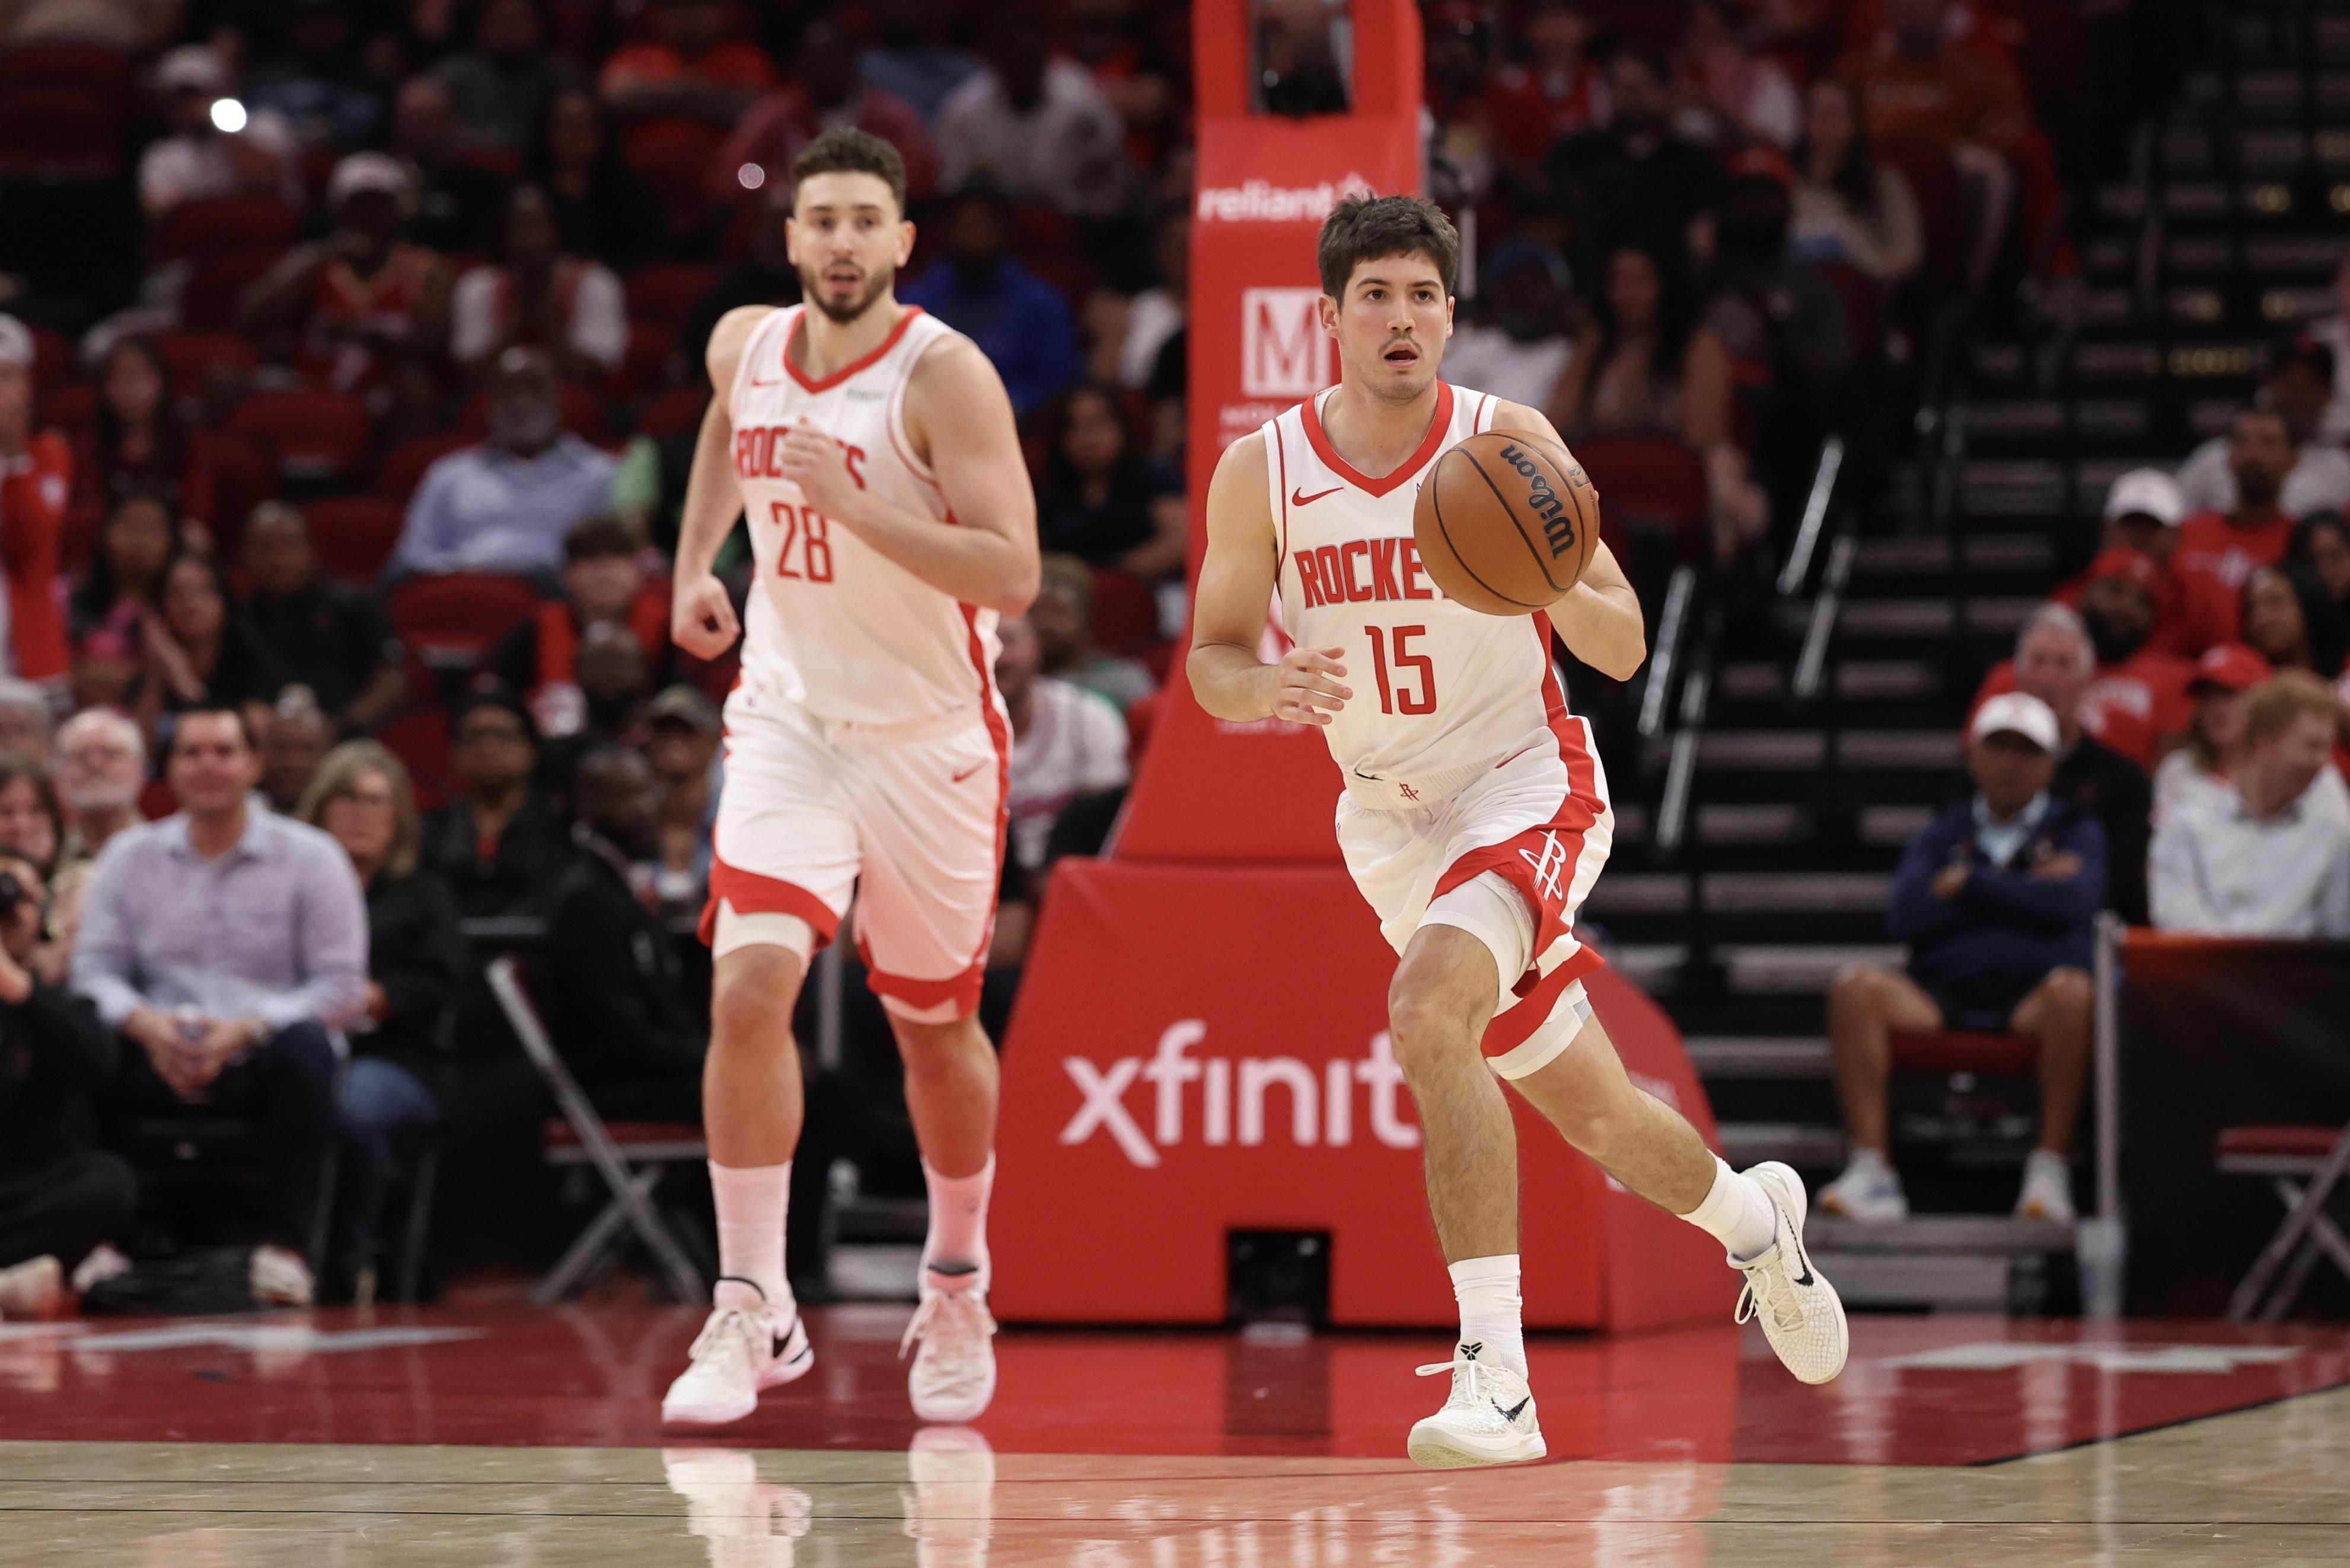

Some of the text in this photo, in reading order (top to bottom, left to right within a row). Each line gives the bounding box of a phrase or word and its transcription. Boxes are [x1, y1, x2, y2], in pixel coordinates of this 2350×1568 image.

[1198, 179, 1333, 222] reliant
[771, 502, 834, 584] 28
[1500, 445, 1576, 560] Wilson
[1293, 536, 1452, 610] ROCKE
[1364, 624, 1437, 716] 15
[1058, 1018, 1421, 1168] xfinit
